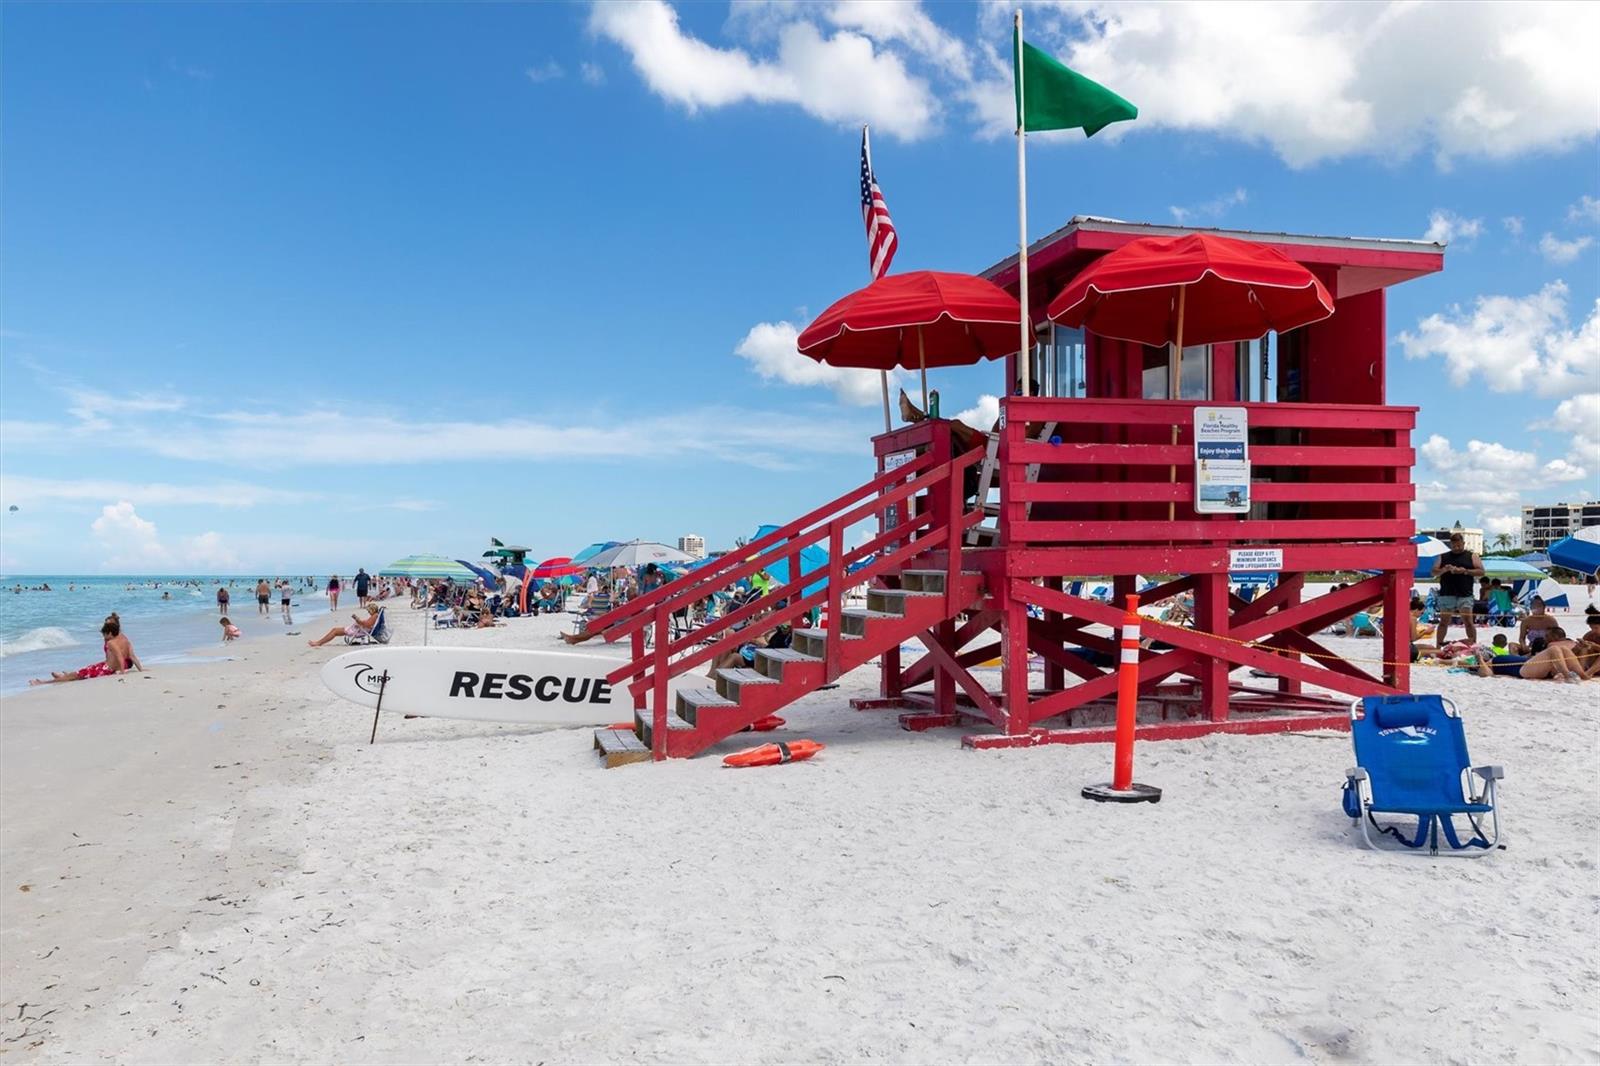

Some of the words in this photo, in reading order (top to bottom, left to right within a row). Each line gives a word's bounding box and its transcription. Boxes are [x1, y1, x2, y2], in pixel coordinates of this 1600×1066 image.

[1200, 447, 1215, 455] Enjoy
[367, 675, 391, 684] MRP
[449, 671, 612, 704] RESCUE
